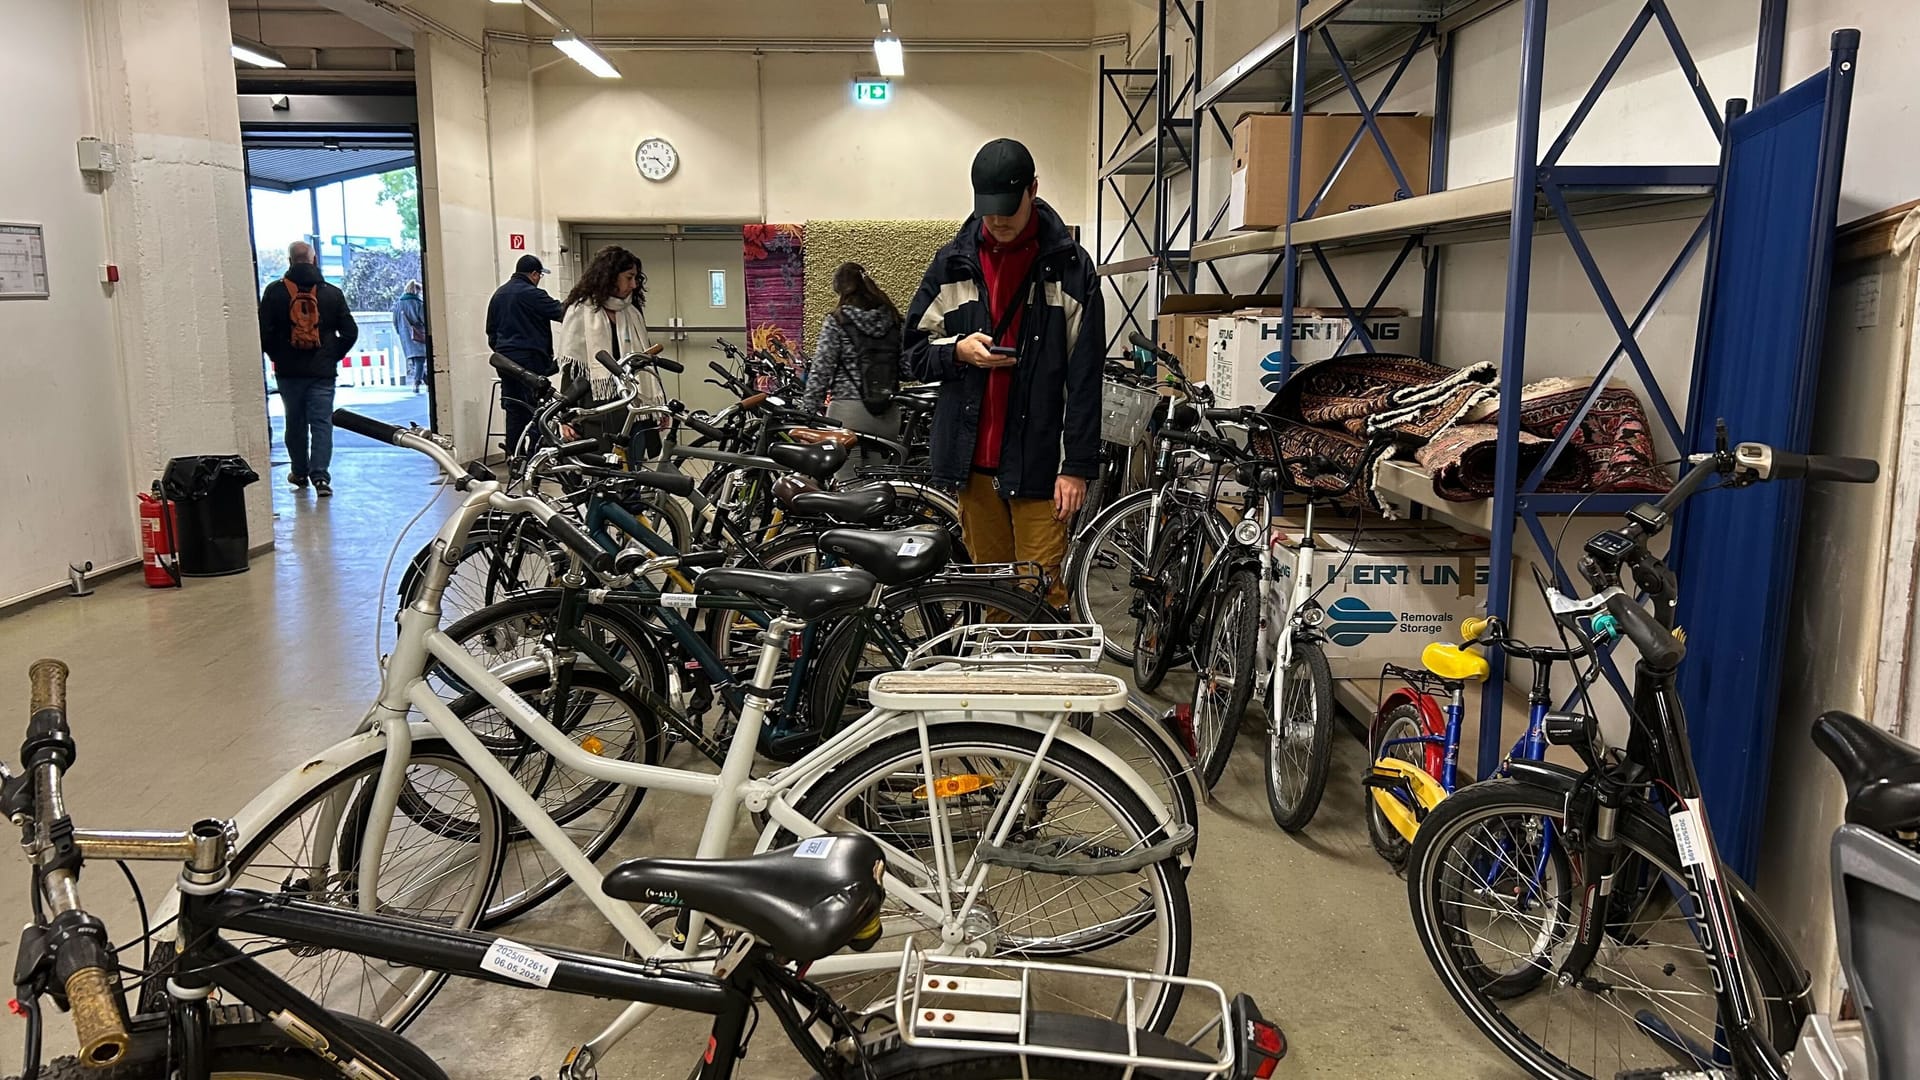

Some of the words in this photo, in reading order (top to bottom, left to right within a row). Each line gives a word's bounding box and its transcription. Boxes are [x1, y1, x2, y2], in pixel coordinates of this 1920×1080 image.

[1400, 612, 1453, 622] Removals
[1400, 623, 1442, 634] Storage
[496, 945, 549, 975] 2025/012614
[494, 957, 541, 981] 06.05.2025
